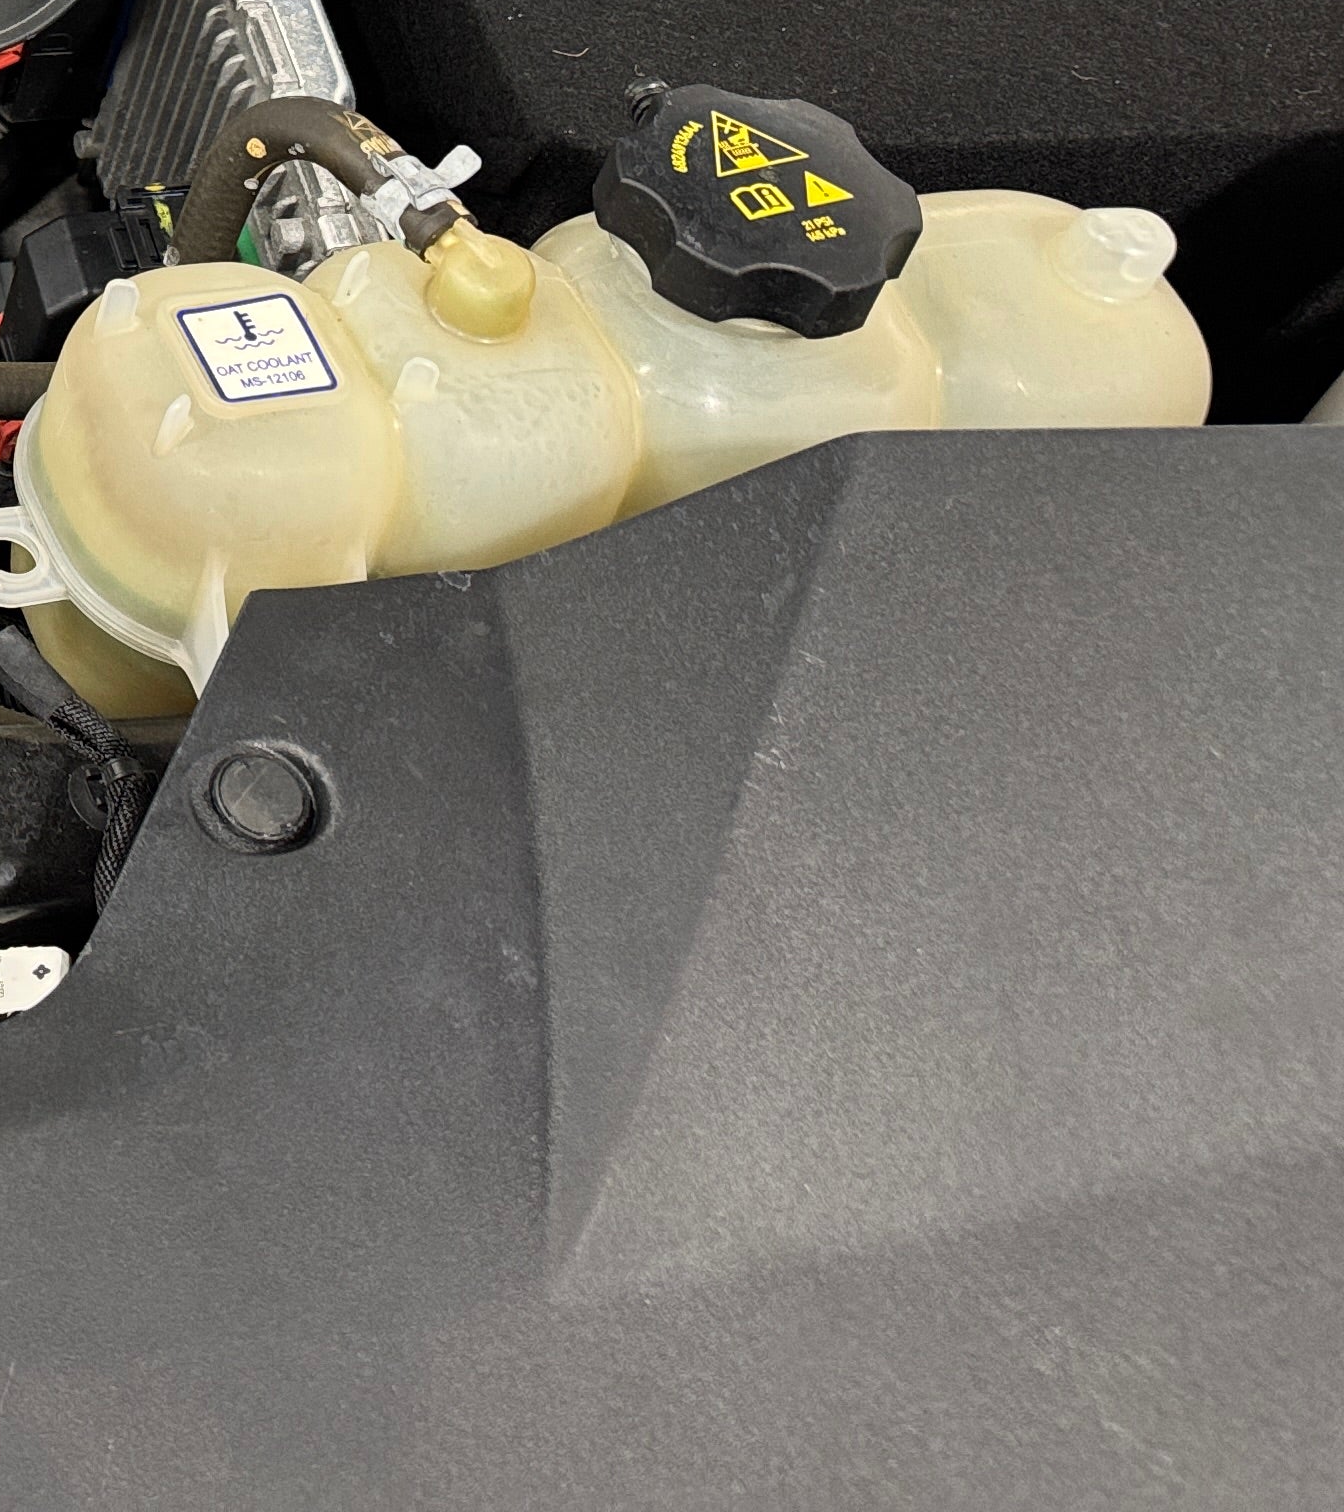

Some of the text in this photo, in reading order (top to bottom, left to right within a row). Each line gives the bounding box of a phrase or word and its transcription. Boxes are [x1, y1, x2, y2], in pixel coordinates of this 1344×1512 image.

[216, 352, 312, 376] OAT COOLANT
[240, 370, 306, 388] MS-12106
